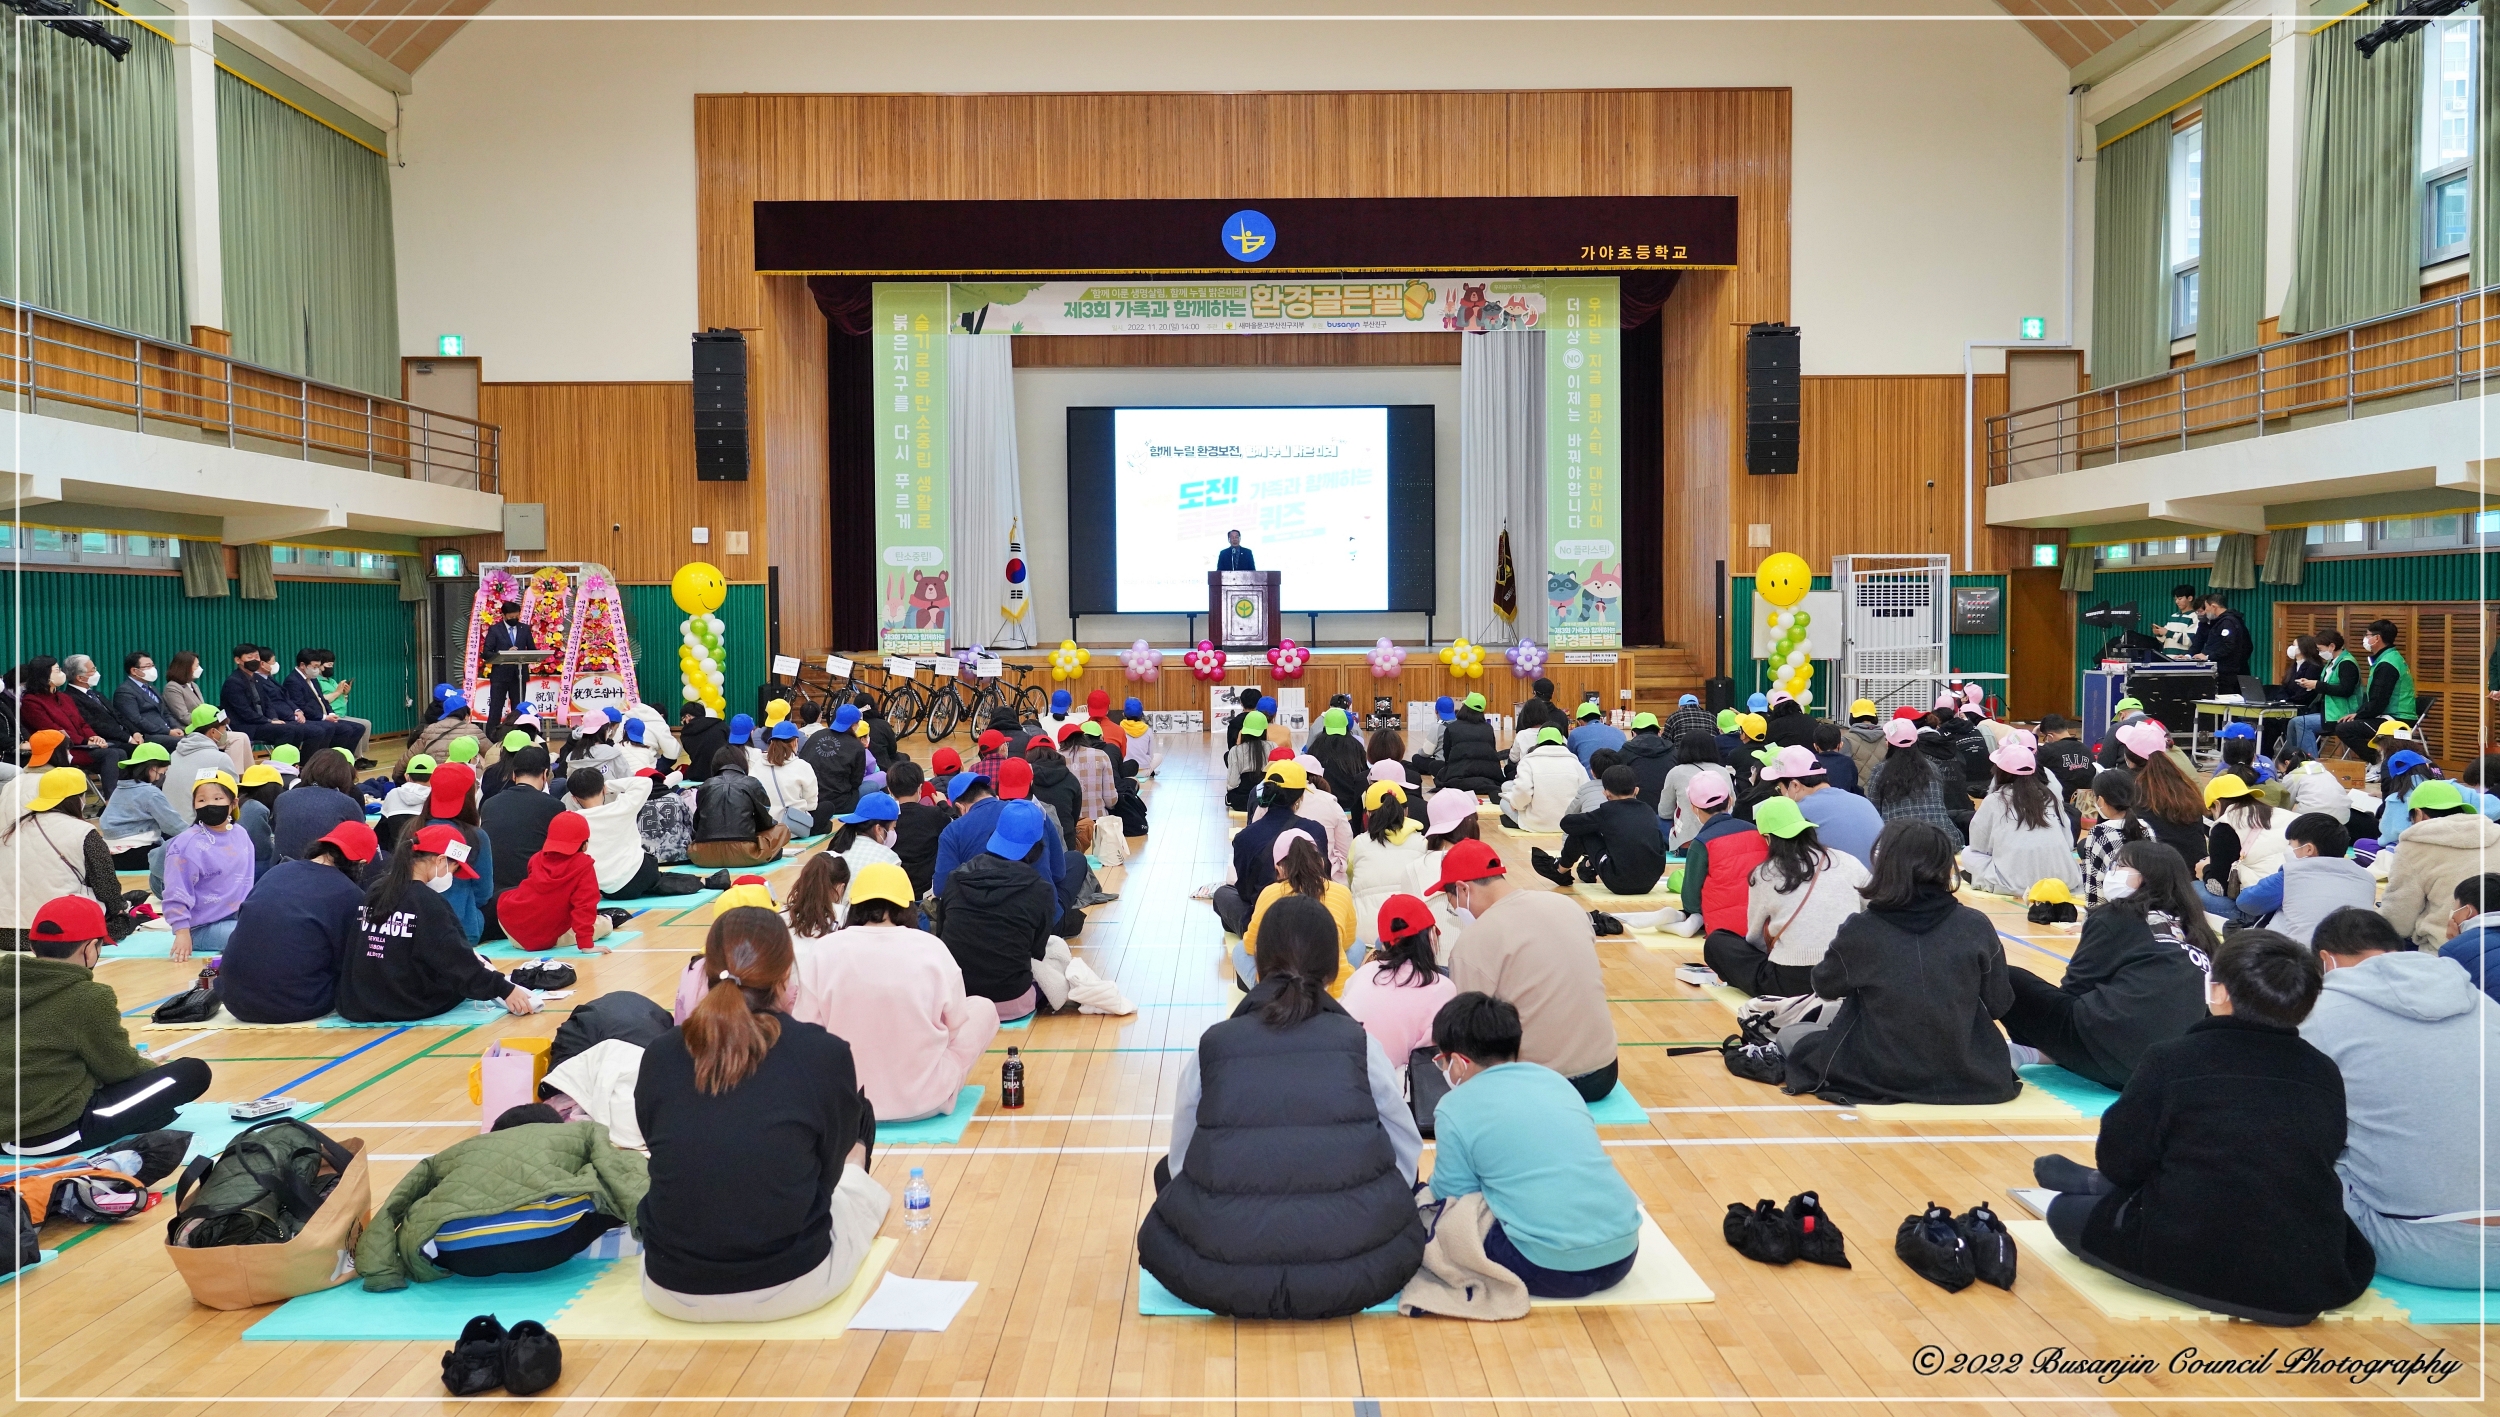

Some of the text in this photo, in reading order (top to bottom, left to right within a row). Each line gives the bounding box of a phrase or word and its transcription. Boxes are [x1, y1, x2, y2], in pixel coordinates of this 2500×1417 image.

[1581, 245, 1688, 260] 가야초등학교
[1130, 288, 1168, 299] 생명살림,
[1170, 288, 1188, 298] 함께
[1189, 287, 1207, 298] 누릴
[1251, 283, 1404, 319] 환경골든벨
[1063, 300, 1246, 319] 제3회 가족과 함께하는
[1128, 323, 1147, 331] 2022.
[1326, 320, 1360, 329] busanjin
[1363, 320, 1387, 328] 부산진구
[1566, 297, 1582, 529] 더이상 NO 이제는 바꿔야합니다
[1588, 297, 1603, 529] 우리는 지금 플라스틱 대란시대
[914, 313, 932, 530] 슬기로운 탄소중립 생활로
[894, 424, 910, 461] 다시
[1150, 445, 1172, 457] 함께
[1174, 445, 1195, 457] 누릴
[1197, 445, 1243, 458] 환경보전,
[1178, 475, 1239, 511] 도전!
[1250, 475, 1302, 500] 가족과
[1304, 467, 1373, 493] 함께하는
[895, 473, 911, 529] 푸르게
[1259, 501, 1306, 531] 퀴즈
[895, 551, 932, 561] 탄소중립!
[1560, 545, 1610, 555] No 플라스틱!
[884, 640, 946, 655] 환경골든벨
[1554, 634, 1616, 648] 환경골든벨
[541, 680, 551, 690] 祝
[535, 691, 555, 703] 祝賀
[2062, 754, 2090, 769] AIR
[451, 848, 463, 859] 59
